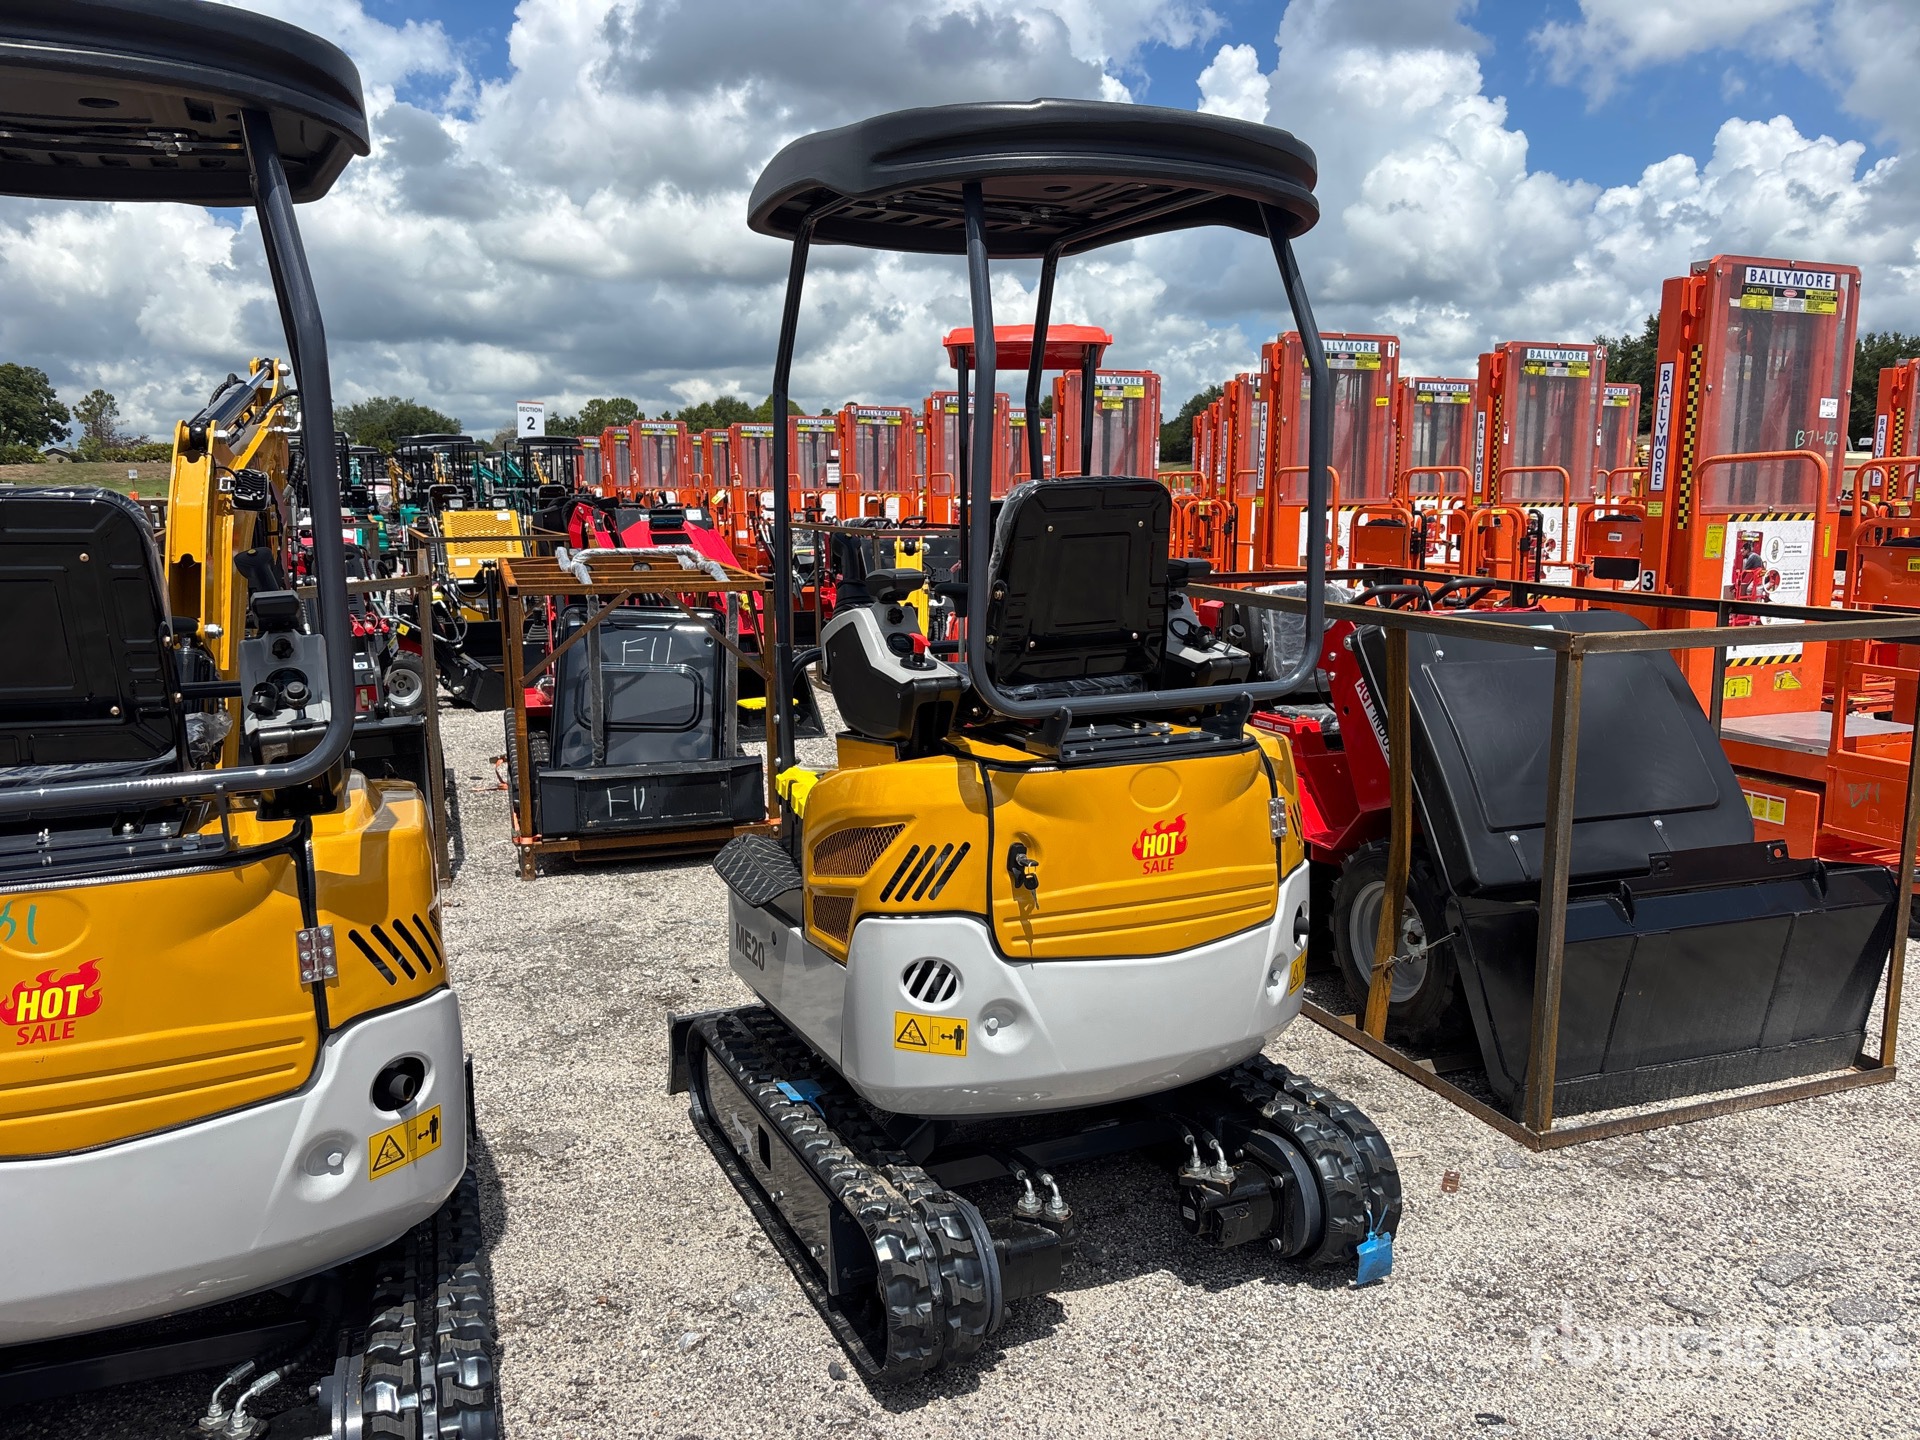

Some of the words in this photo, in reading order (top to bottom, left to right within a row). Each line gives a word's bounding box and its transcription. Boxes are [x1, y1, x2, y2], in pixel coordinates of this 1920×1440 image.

[1750, 268, 1831, 288] BALLYMORE
[1746, 286, 1769, 294] CAUTION
[1323, 342, 1375, 352] LLYMORE
[1530, 350, 1586, 361] BALLYMORE
[1596, 346, 1602, 358] 2
[1094, 376, 1141, 385] ALLYMORE
[1421, 383, 1467, 391] BALLYMORE
[526, 416, 535, 430] 2
[1654, 370, 1670, 486] BALLYMORE
[1258, 405, 1267, 486] BALLYMORE
[1795, 430, 1839, 449] B71-122
[1475, 414, 1484, 490] BALLYMORE
[1874, 418, 1885, 484] BALLYRE
[1642, 571, 1654, 591] 3
[1356, 681, 1374, 710] AGT
[1142, 831, 1180, 859] HOT
[1142, 857, 1175, 876] SALE
[735, 921, 765, 972] ME20
[15, 983, 85, 1023] HOT
[15, 1019, 77, 1046] SALE
